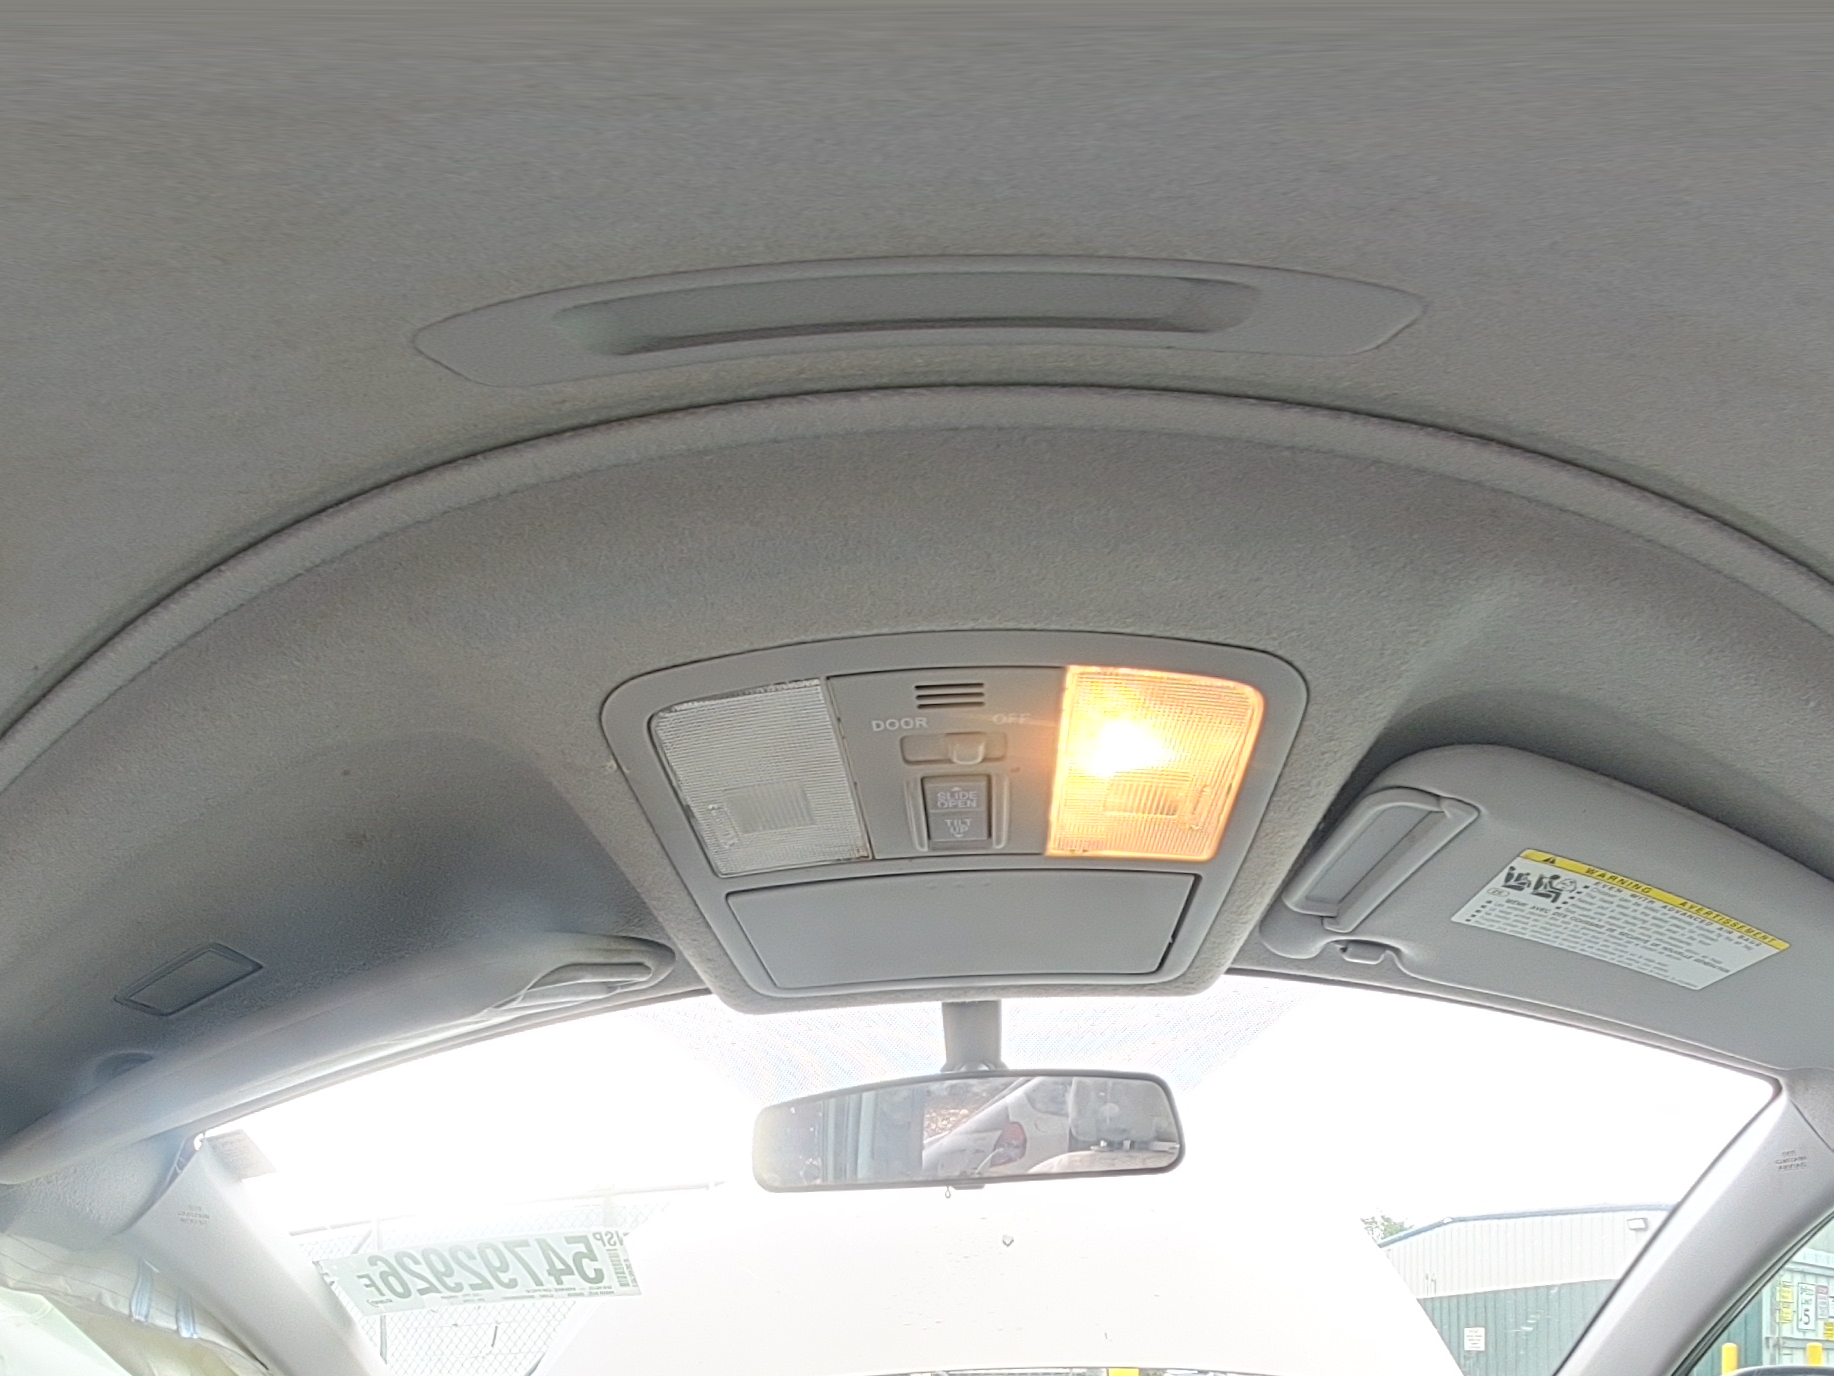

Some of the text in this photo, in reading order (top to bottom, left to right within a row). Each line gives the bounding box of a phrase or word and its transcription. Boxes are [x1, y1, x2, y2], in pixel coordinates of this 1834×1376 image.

[871, 717, 928, 731] DOOR
[992, 713, 1032, 725] OFF
[937, 791, 978, 800] SLIDE
[937, 799, 977, 809] OPEN
[945, 818, 973, 827] TILT
[950, 826, 969, 834] UP
[1585, 867, 1652, 894] WARNING
[1679, 901, 1777, 943] AVERTISSEMENT
[1660, 904, 1714, 926] ADVANCED
